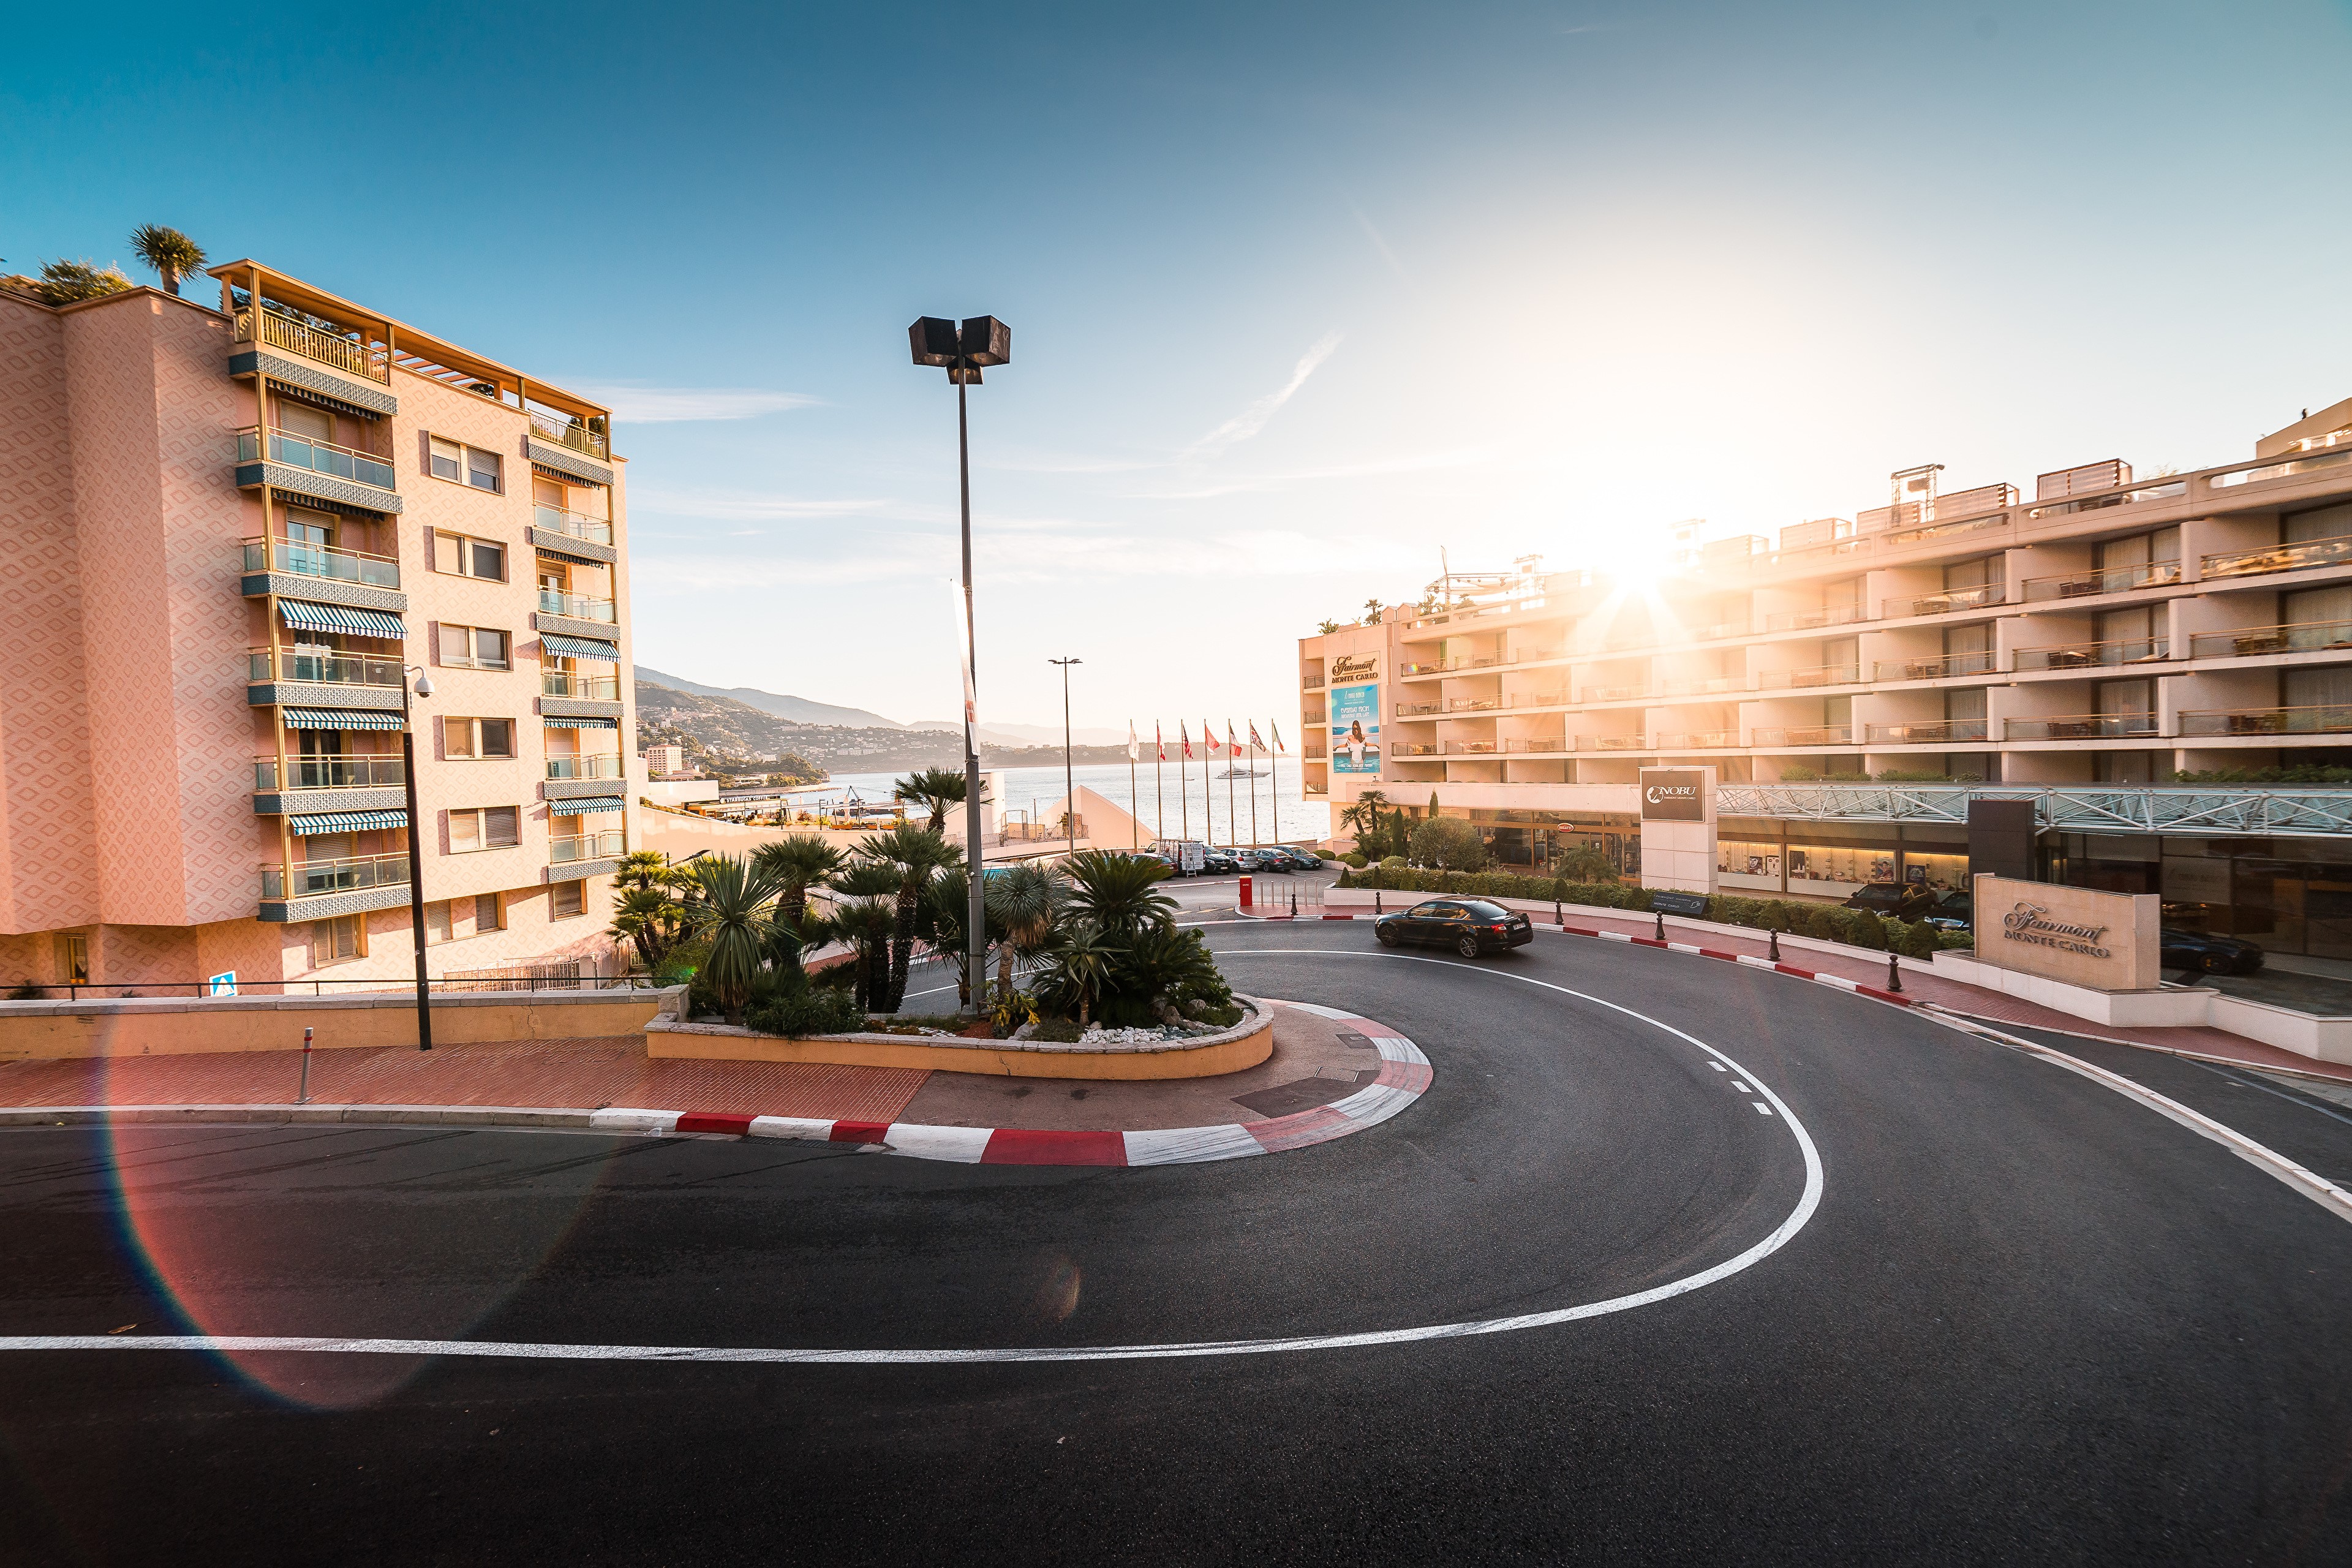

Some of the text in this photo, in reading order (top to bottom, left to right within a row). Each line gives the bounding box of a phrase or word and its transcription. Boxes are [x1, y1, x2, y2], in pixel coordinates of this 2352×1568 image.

[1332, 656, 1377, 676] Fairmont
[1332, 672, 1378, 684] MONTE CARLO
[1659, 786, 1697, 795] NOBU
[2003, 901, 2108, 945] Fairmont
[2004, 930, 2110, 958] MONTE CARLO
